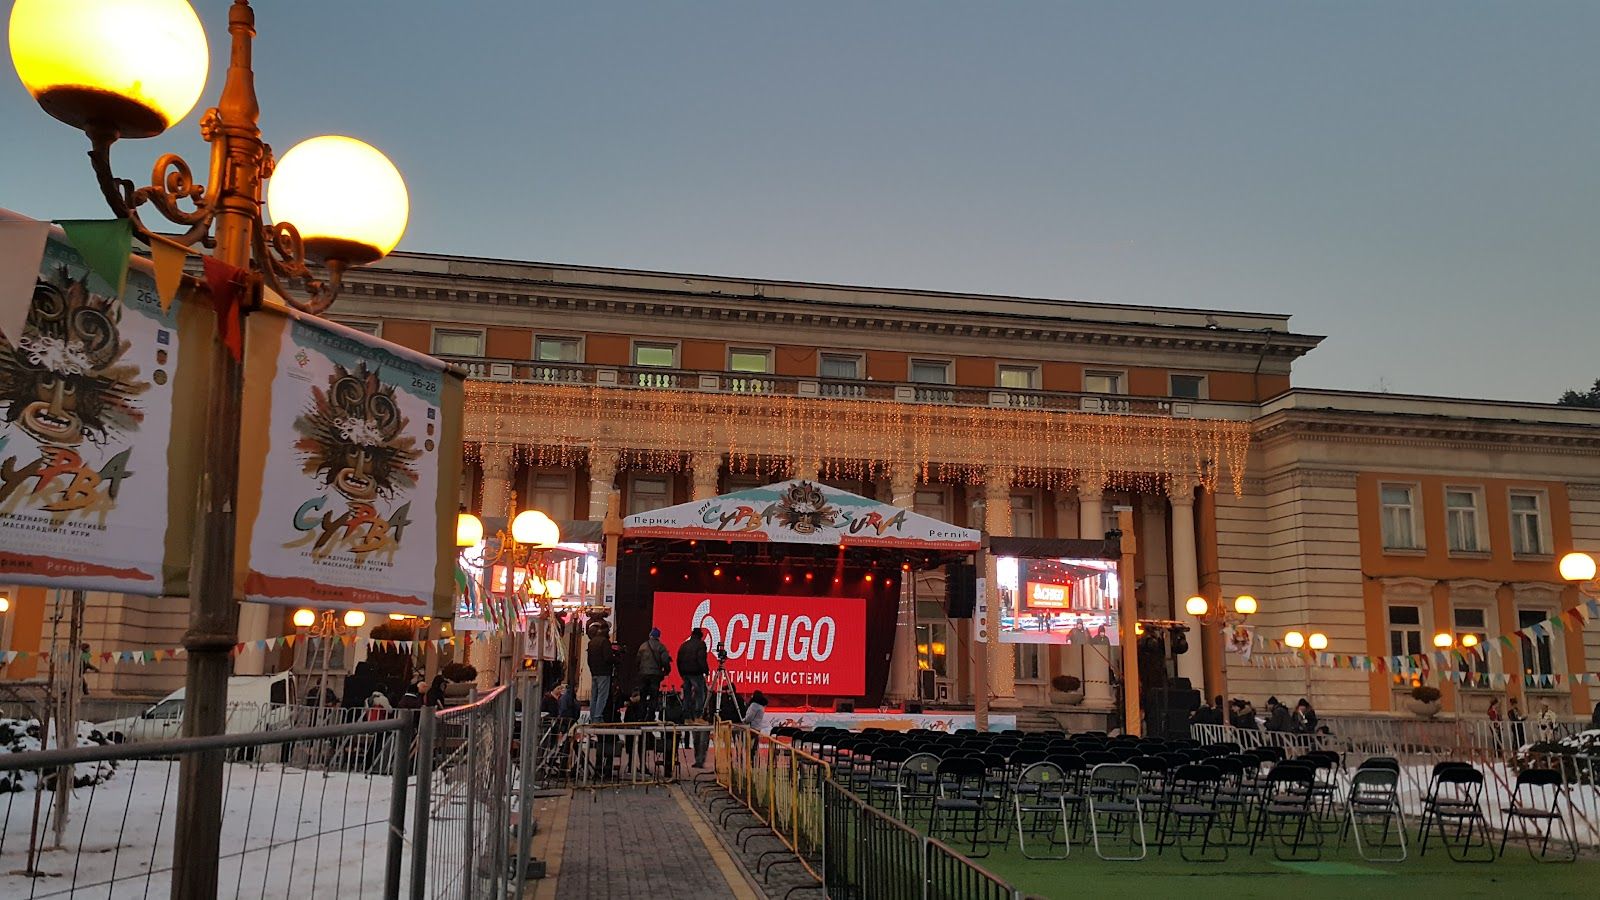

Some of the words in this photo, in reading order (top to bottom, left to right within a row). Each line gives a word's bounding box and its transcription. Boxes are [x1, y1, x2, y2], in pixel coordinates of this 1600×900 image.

[411, 377, 437, 393] 26-28
[0, 437, 135, 512] УРВА
[293, 494, 415, 553] СУРВА
[634, 516, 677, 526] Перник
[702, 503, 776, 532] СУРВА
[834, 510, 907, 536] SURVA
[929, 529, 969, 538] Pernik
[0, 558, 33, 568] рник
[47, 560, 88, 573] Pernik
[724, 613, 836, 662] CHIGO
[774, 672, 830, 685] СИСТЕМИ
